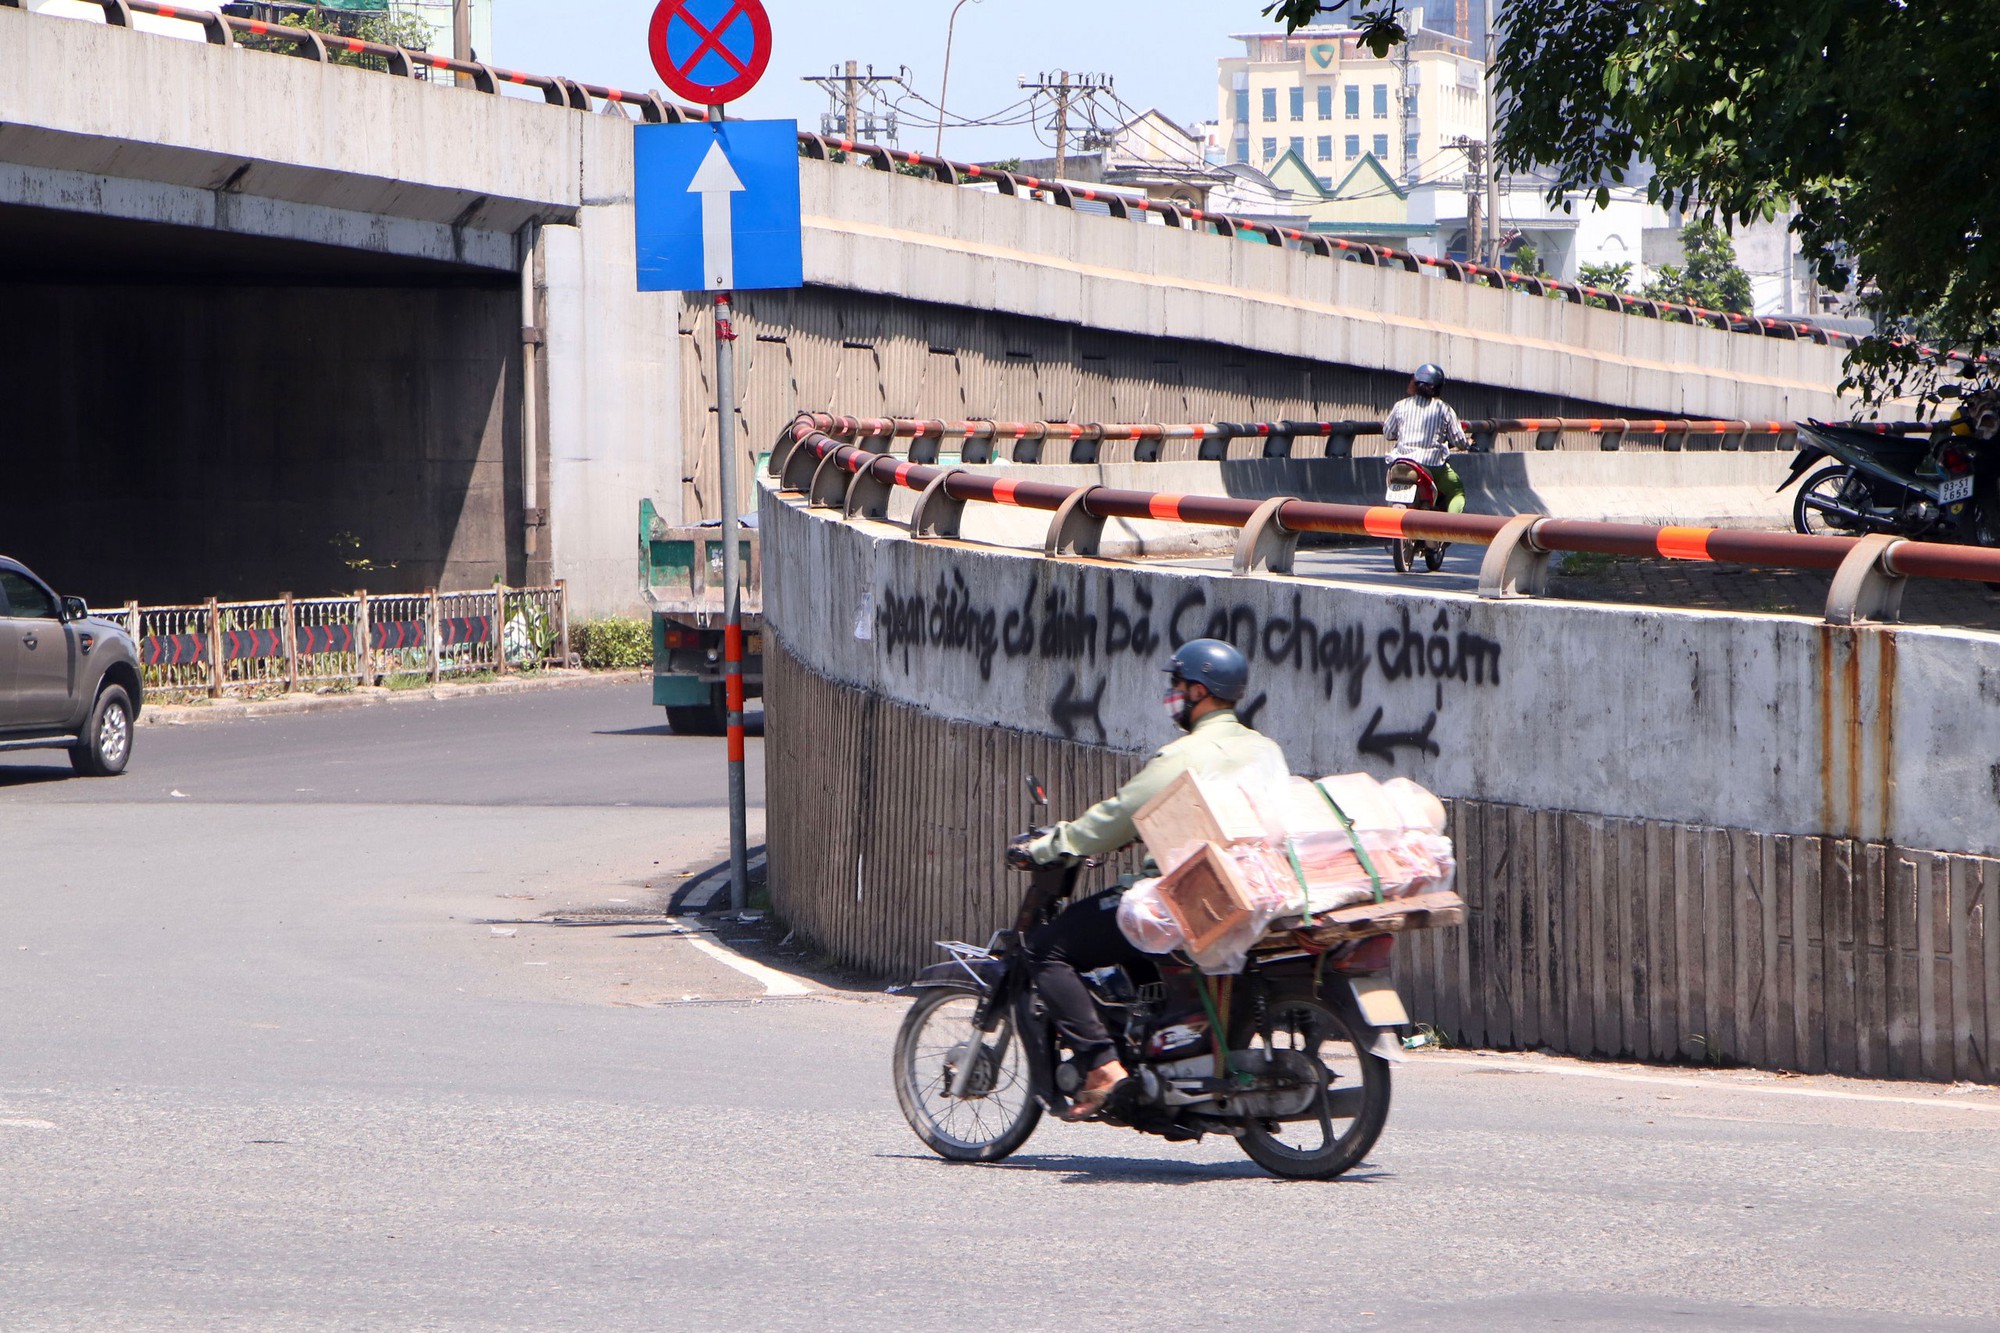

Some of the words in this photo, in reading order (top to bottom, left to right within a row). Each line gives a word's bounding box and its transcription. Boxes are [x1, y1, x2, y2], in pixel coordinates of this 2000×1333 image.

[1003, 574, 1038, 657] có
[1106, 575, 1160, 656] bà
[1262, 591, 1371, 708] chạy
[1377, 606, 1501, 711] chậm
